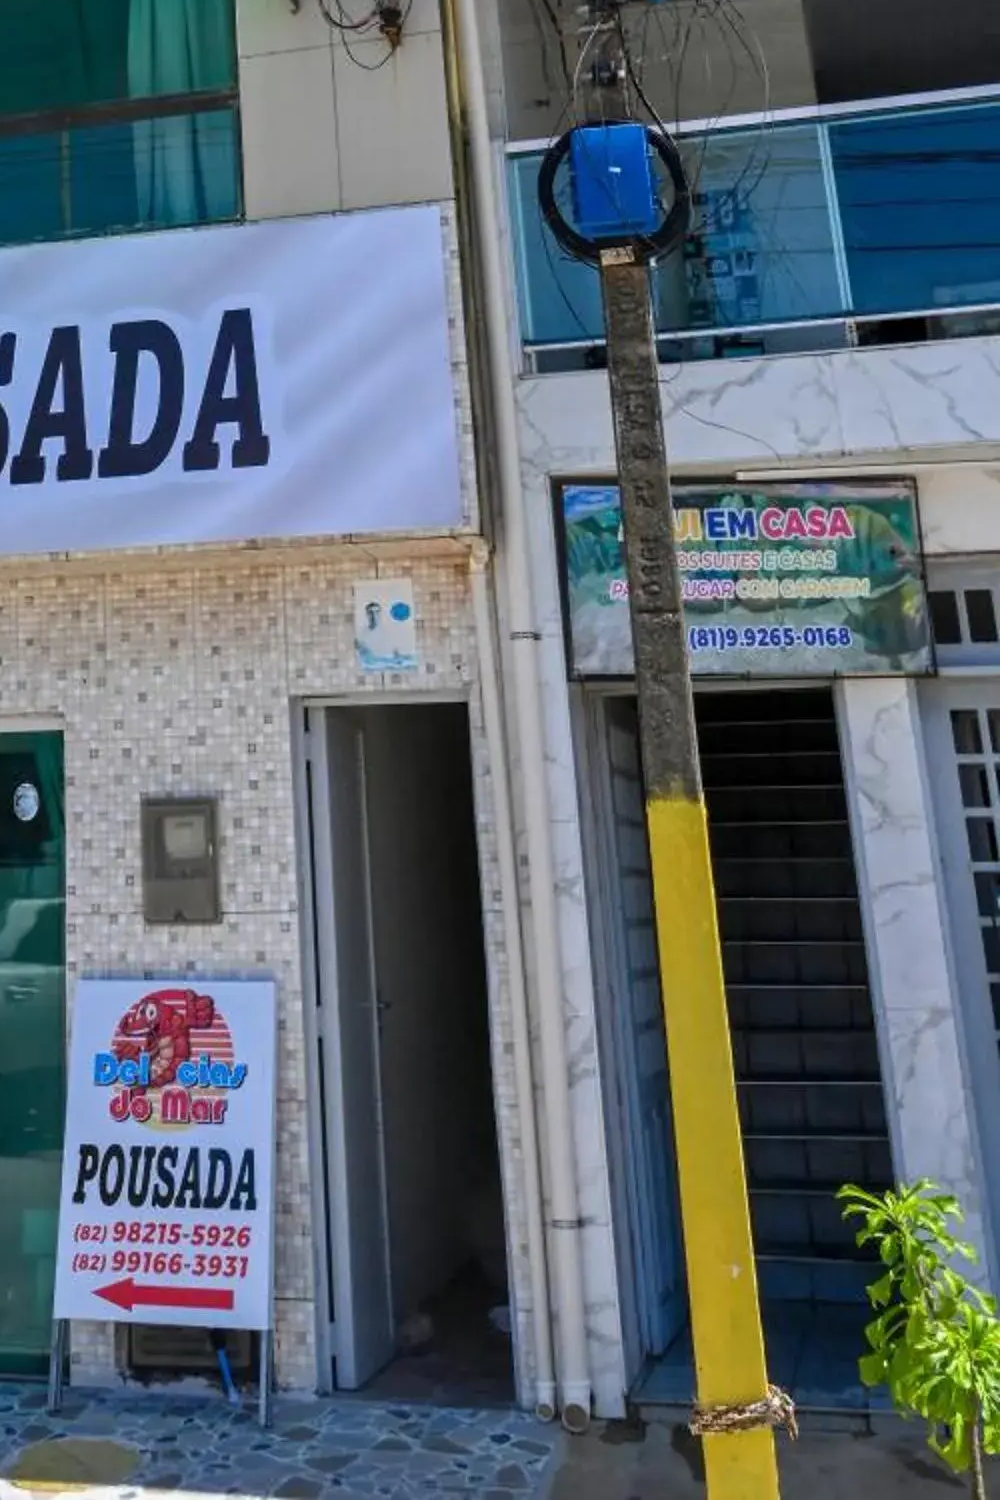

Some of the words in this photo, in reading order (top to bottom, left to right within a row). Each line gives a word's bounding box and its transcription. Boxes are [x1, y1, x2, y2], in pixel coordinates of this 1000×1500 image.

[703, 508, 758, 540] EM
[760, 507, 856, 540] CASA
[700, 551, 762, 571] SUITES
[778, 550, 837, 570] CASAS
[109, 1086, 152, 1122] do
[161, 1085, 229, 1125] Mar
[72, 1143, 257, 1211] POUSADA
[73, 1223, 108, 1244] (82)
[112, 1220, 253, 1249] 98215-5926
[71, 1253, 107, 1273] (82)
[110, 1249, 249, 1279] 99166-3931
